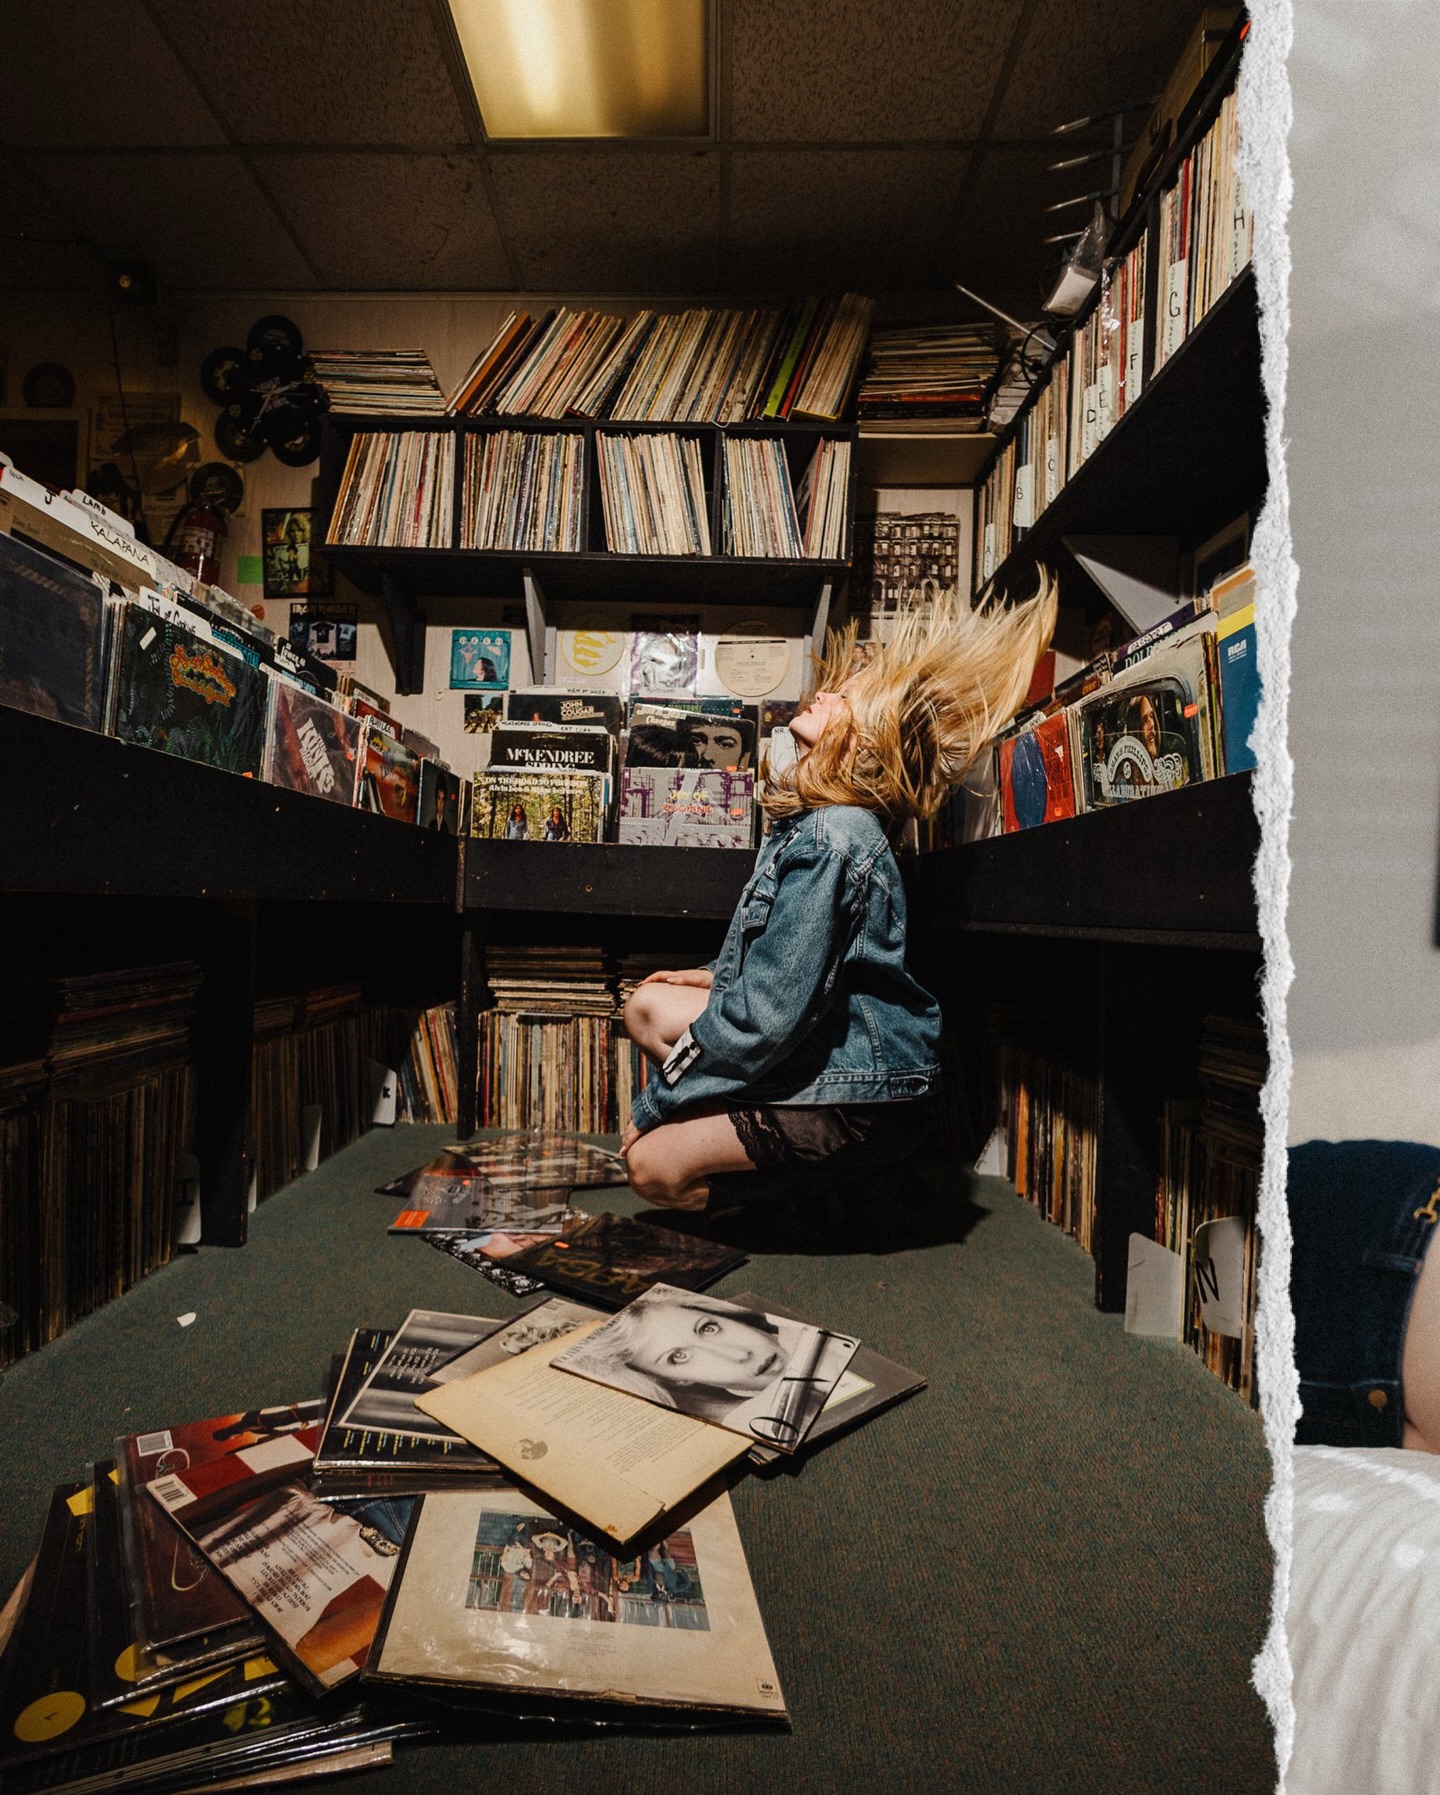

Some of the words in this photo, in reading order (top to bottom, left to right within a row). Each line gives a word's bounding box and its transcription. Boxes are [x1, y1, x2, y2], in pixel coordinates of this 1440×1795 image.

[1233, 208, 1245, 230] H
[1169, 291, 1181, 317] G
[1130, 353, 1138, 370] F
[1099, 391, 1108, 408] E
[1086, 409, 1096, 423] D
[1048, 458, 1055, 471] C
[44, 489, 57, 505] J
[1016, 487, 1024, 500] B
[1227, 639, 1247, 657] RCA
[560, 699, 582, 711] JOHN
[560, 705, 595, 717] COUGAR
[661, 802, 714, 814] COOKING
[1195, 1257, 1220, 1304] N
